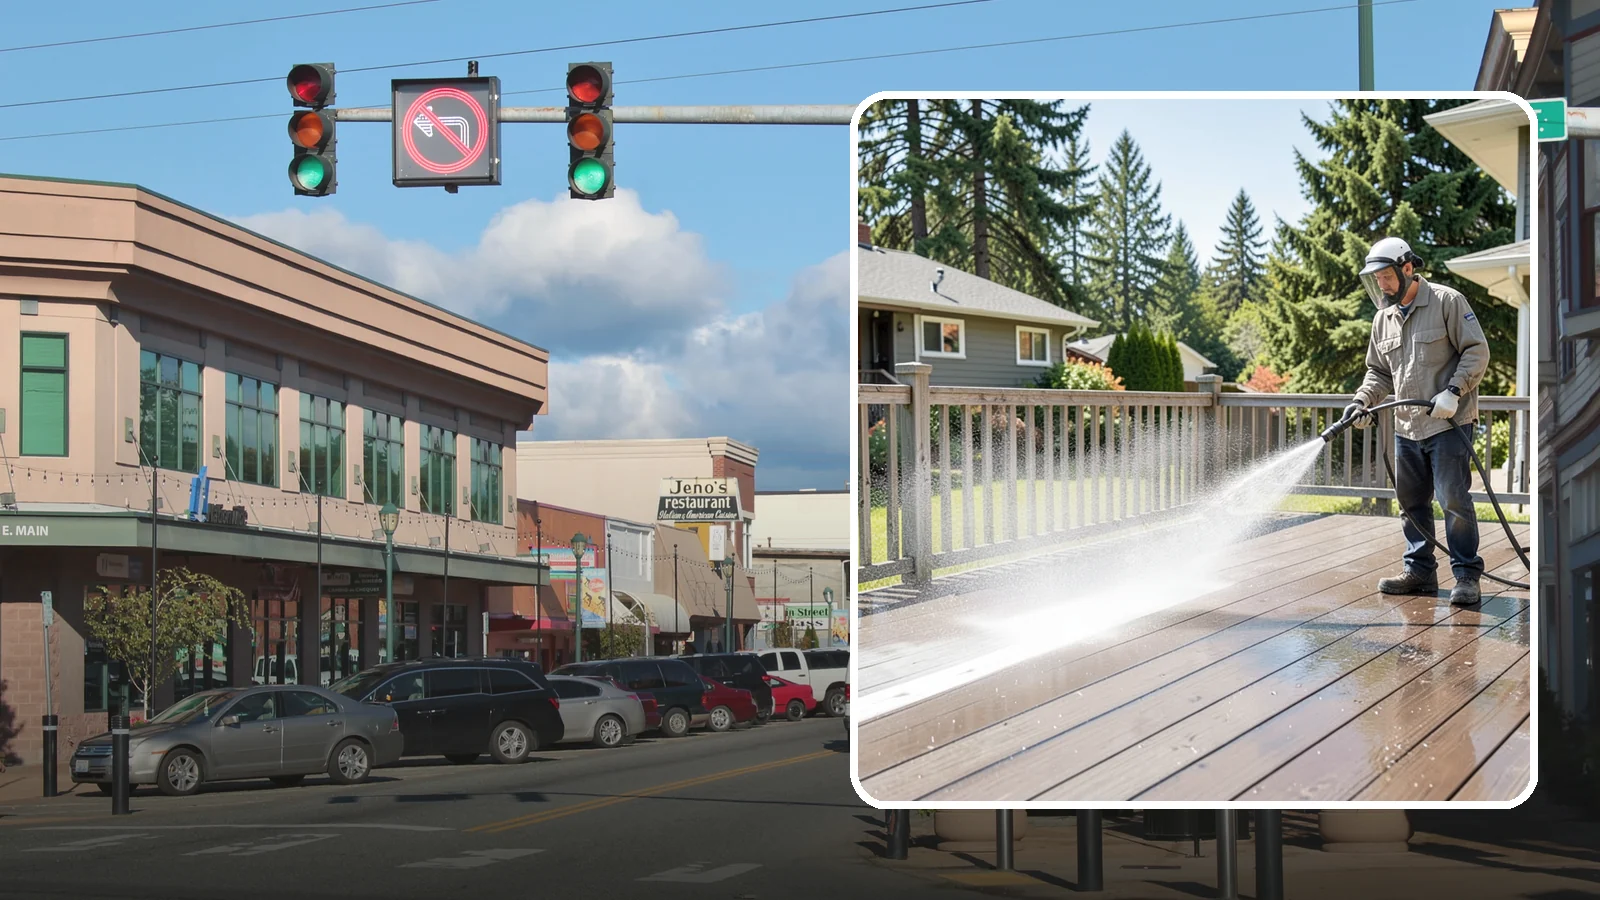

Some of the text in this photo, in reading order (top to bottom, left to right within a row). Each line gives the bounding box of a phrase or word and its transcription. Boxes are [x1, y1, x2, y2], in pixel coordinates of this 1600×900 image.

[670, 480, 727, 494] Jeno's
[665, 496, 731, 509] restaurant
[658, 510, 682, 519] Italian
[685, 510, 714, 519] American
[715, 510, 737, 519] Cuisine
[2, 525, 49, 536] E. MAIN
[797, 608, 828, 616] Street
